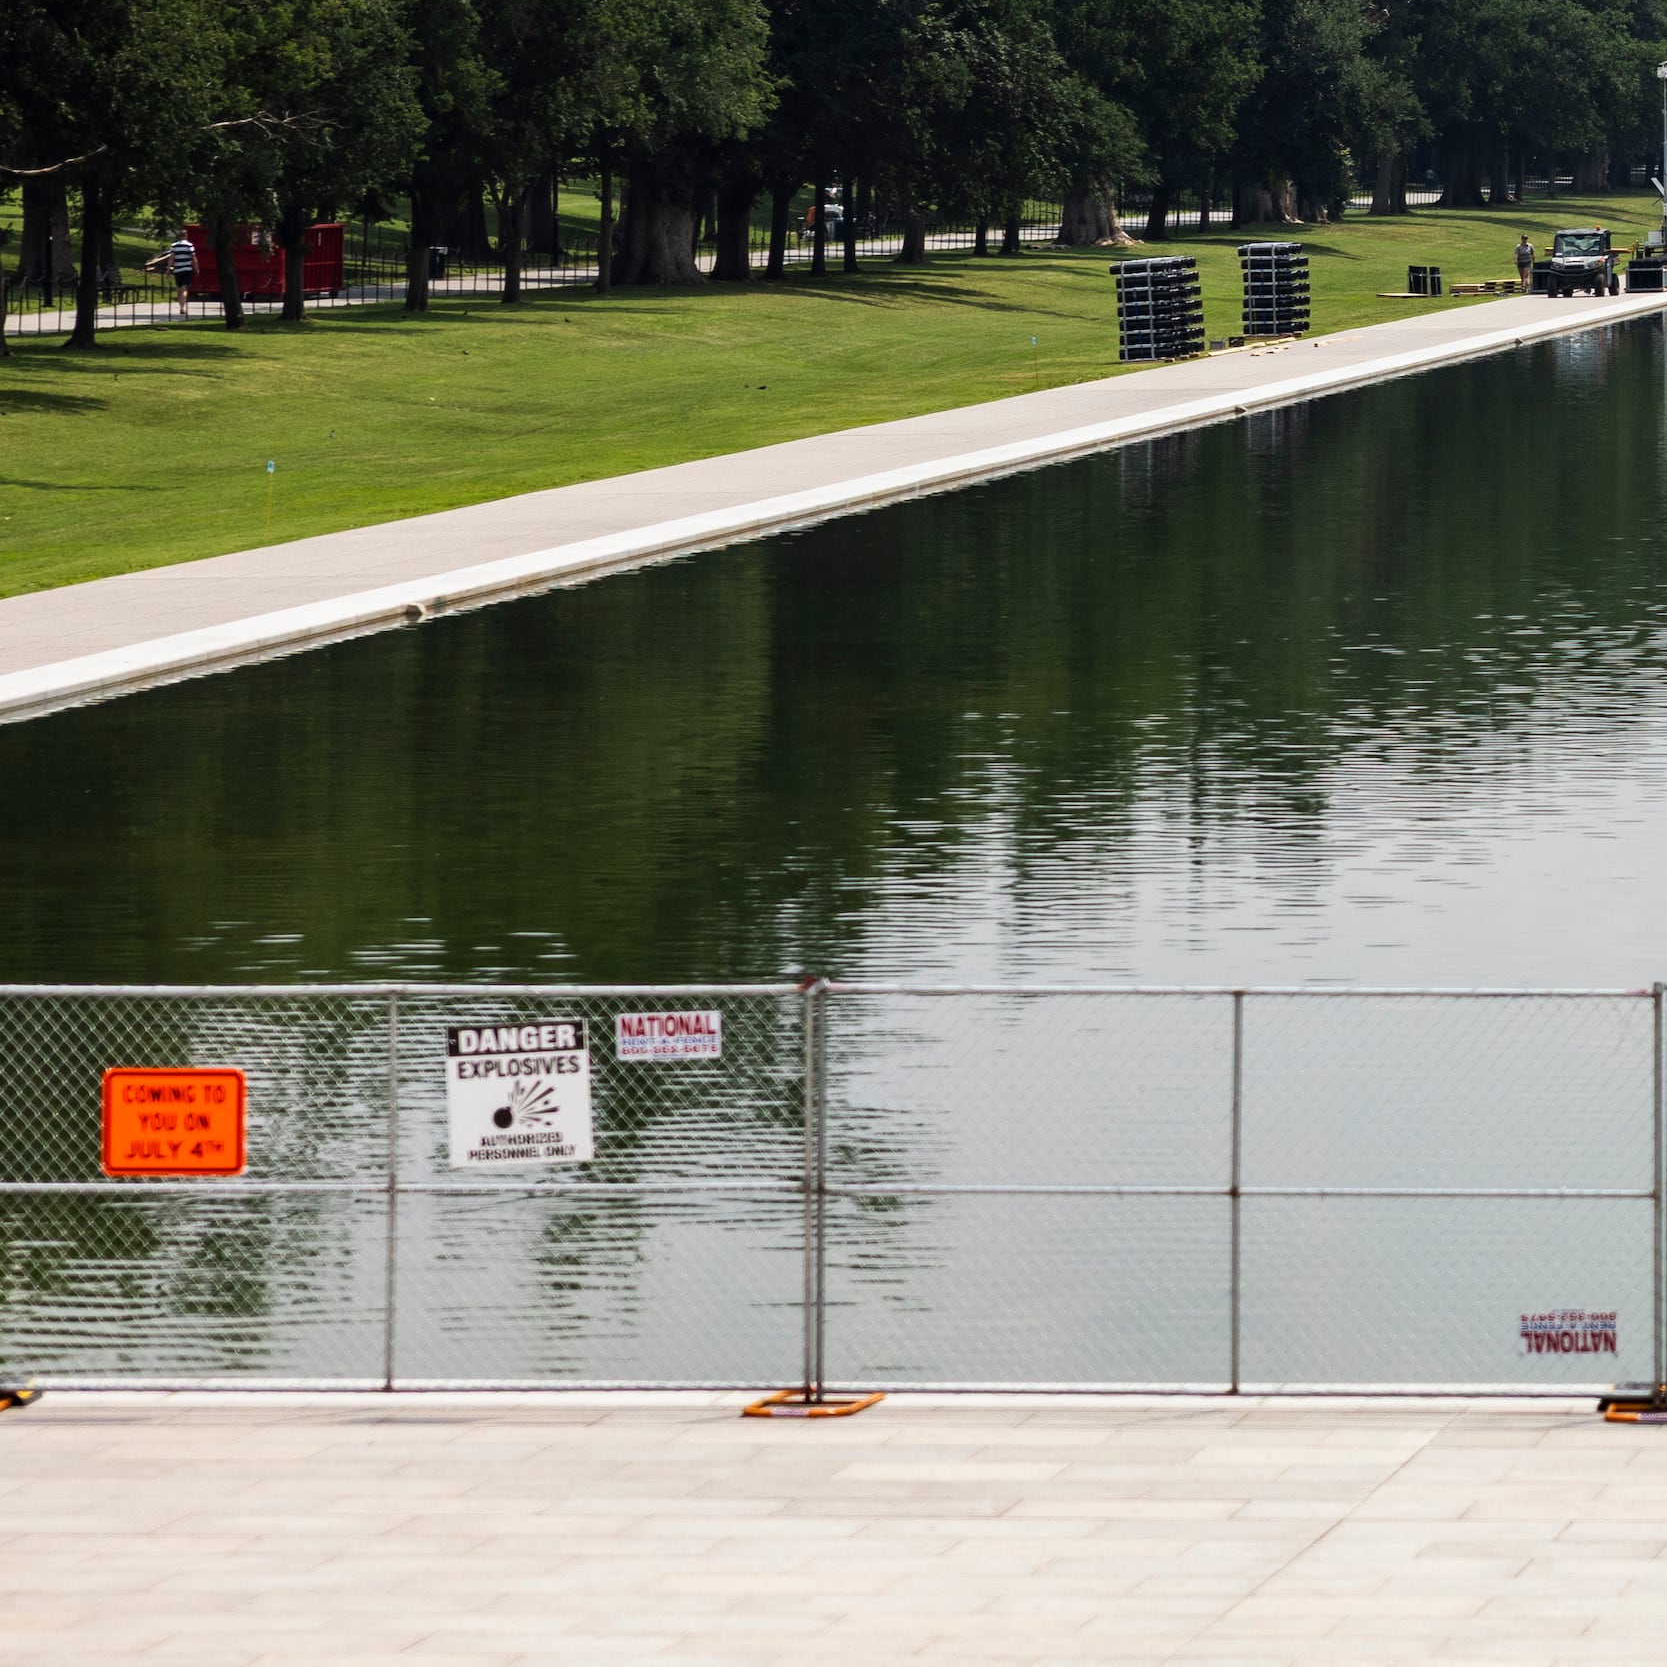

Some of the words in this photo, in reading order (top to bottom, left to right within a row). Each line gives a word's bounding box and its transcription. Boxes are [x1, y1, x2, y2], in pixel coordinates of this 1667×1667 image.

[621, 1014, 716, 1037] NATIONAL
[458, 1024, 577, 1053] DANGER
[457, 1055, 580, 1079] EXPLOSIVES
[123, 1085, 196, 1103] COMING
[204, 1085, 226, 1103] TO
[138, 1112, 178, 1130] YOU
[184, 1112, 210, 1130] ON
[480, 1132, 564, 1146] AUTHORIZED
[125, 1140, 183, 1159] JULY
[191, 1140, 225, 1158] 4TH
[469, 1147, 540, 1161] PERSONNEL
[547, 1145, 577, 1157] ONLY
[1520, 1331, 1617, 1353] NATIONAL
